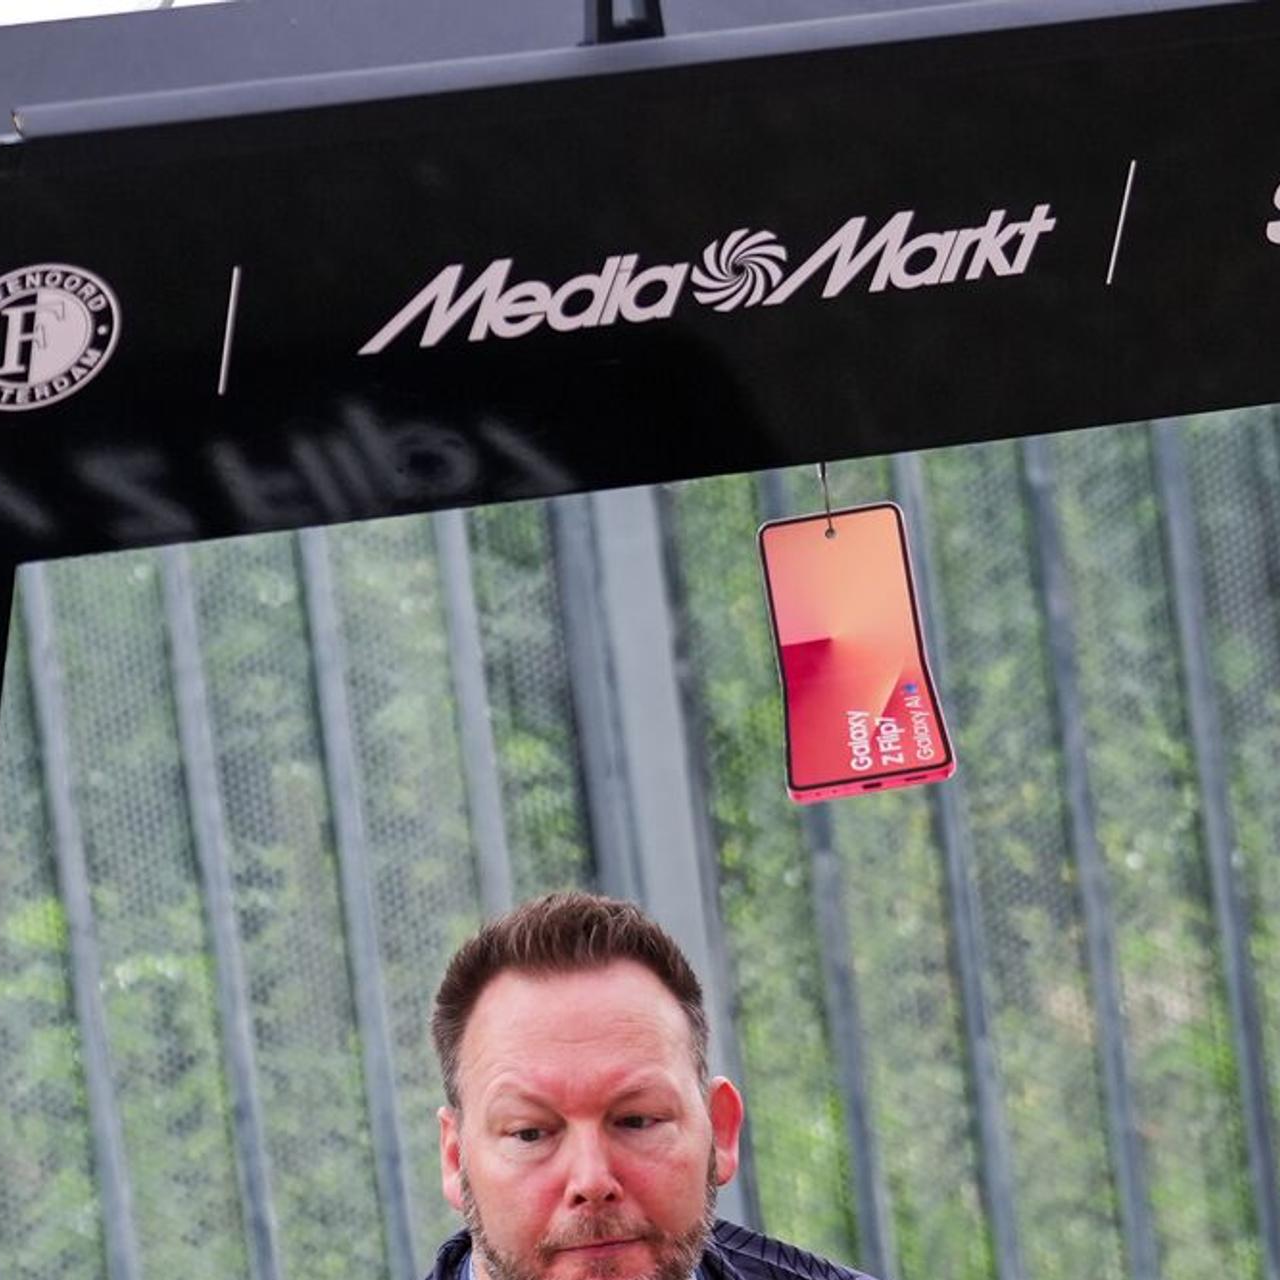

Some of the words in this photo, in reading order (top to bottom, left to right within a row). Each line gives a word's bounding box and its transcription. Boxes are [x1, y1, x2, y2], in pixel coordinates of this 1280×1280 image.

[904, 695, 922, 708] AI
[846, 710, 872, 771] Galaxy
[875, 716, 905, 752] Flip7
[909, 710, 935, 760] Galaxy
[881, 752, 904, 766] Z
